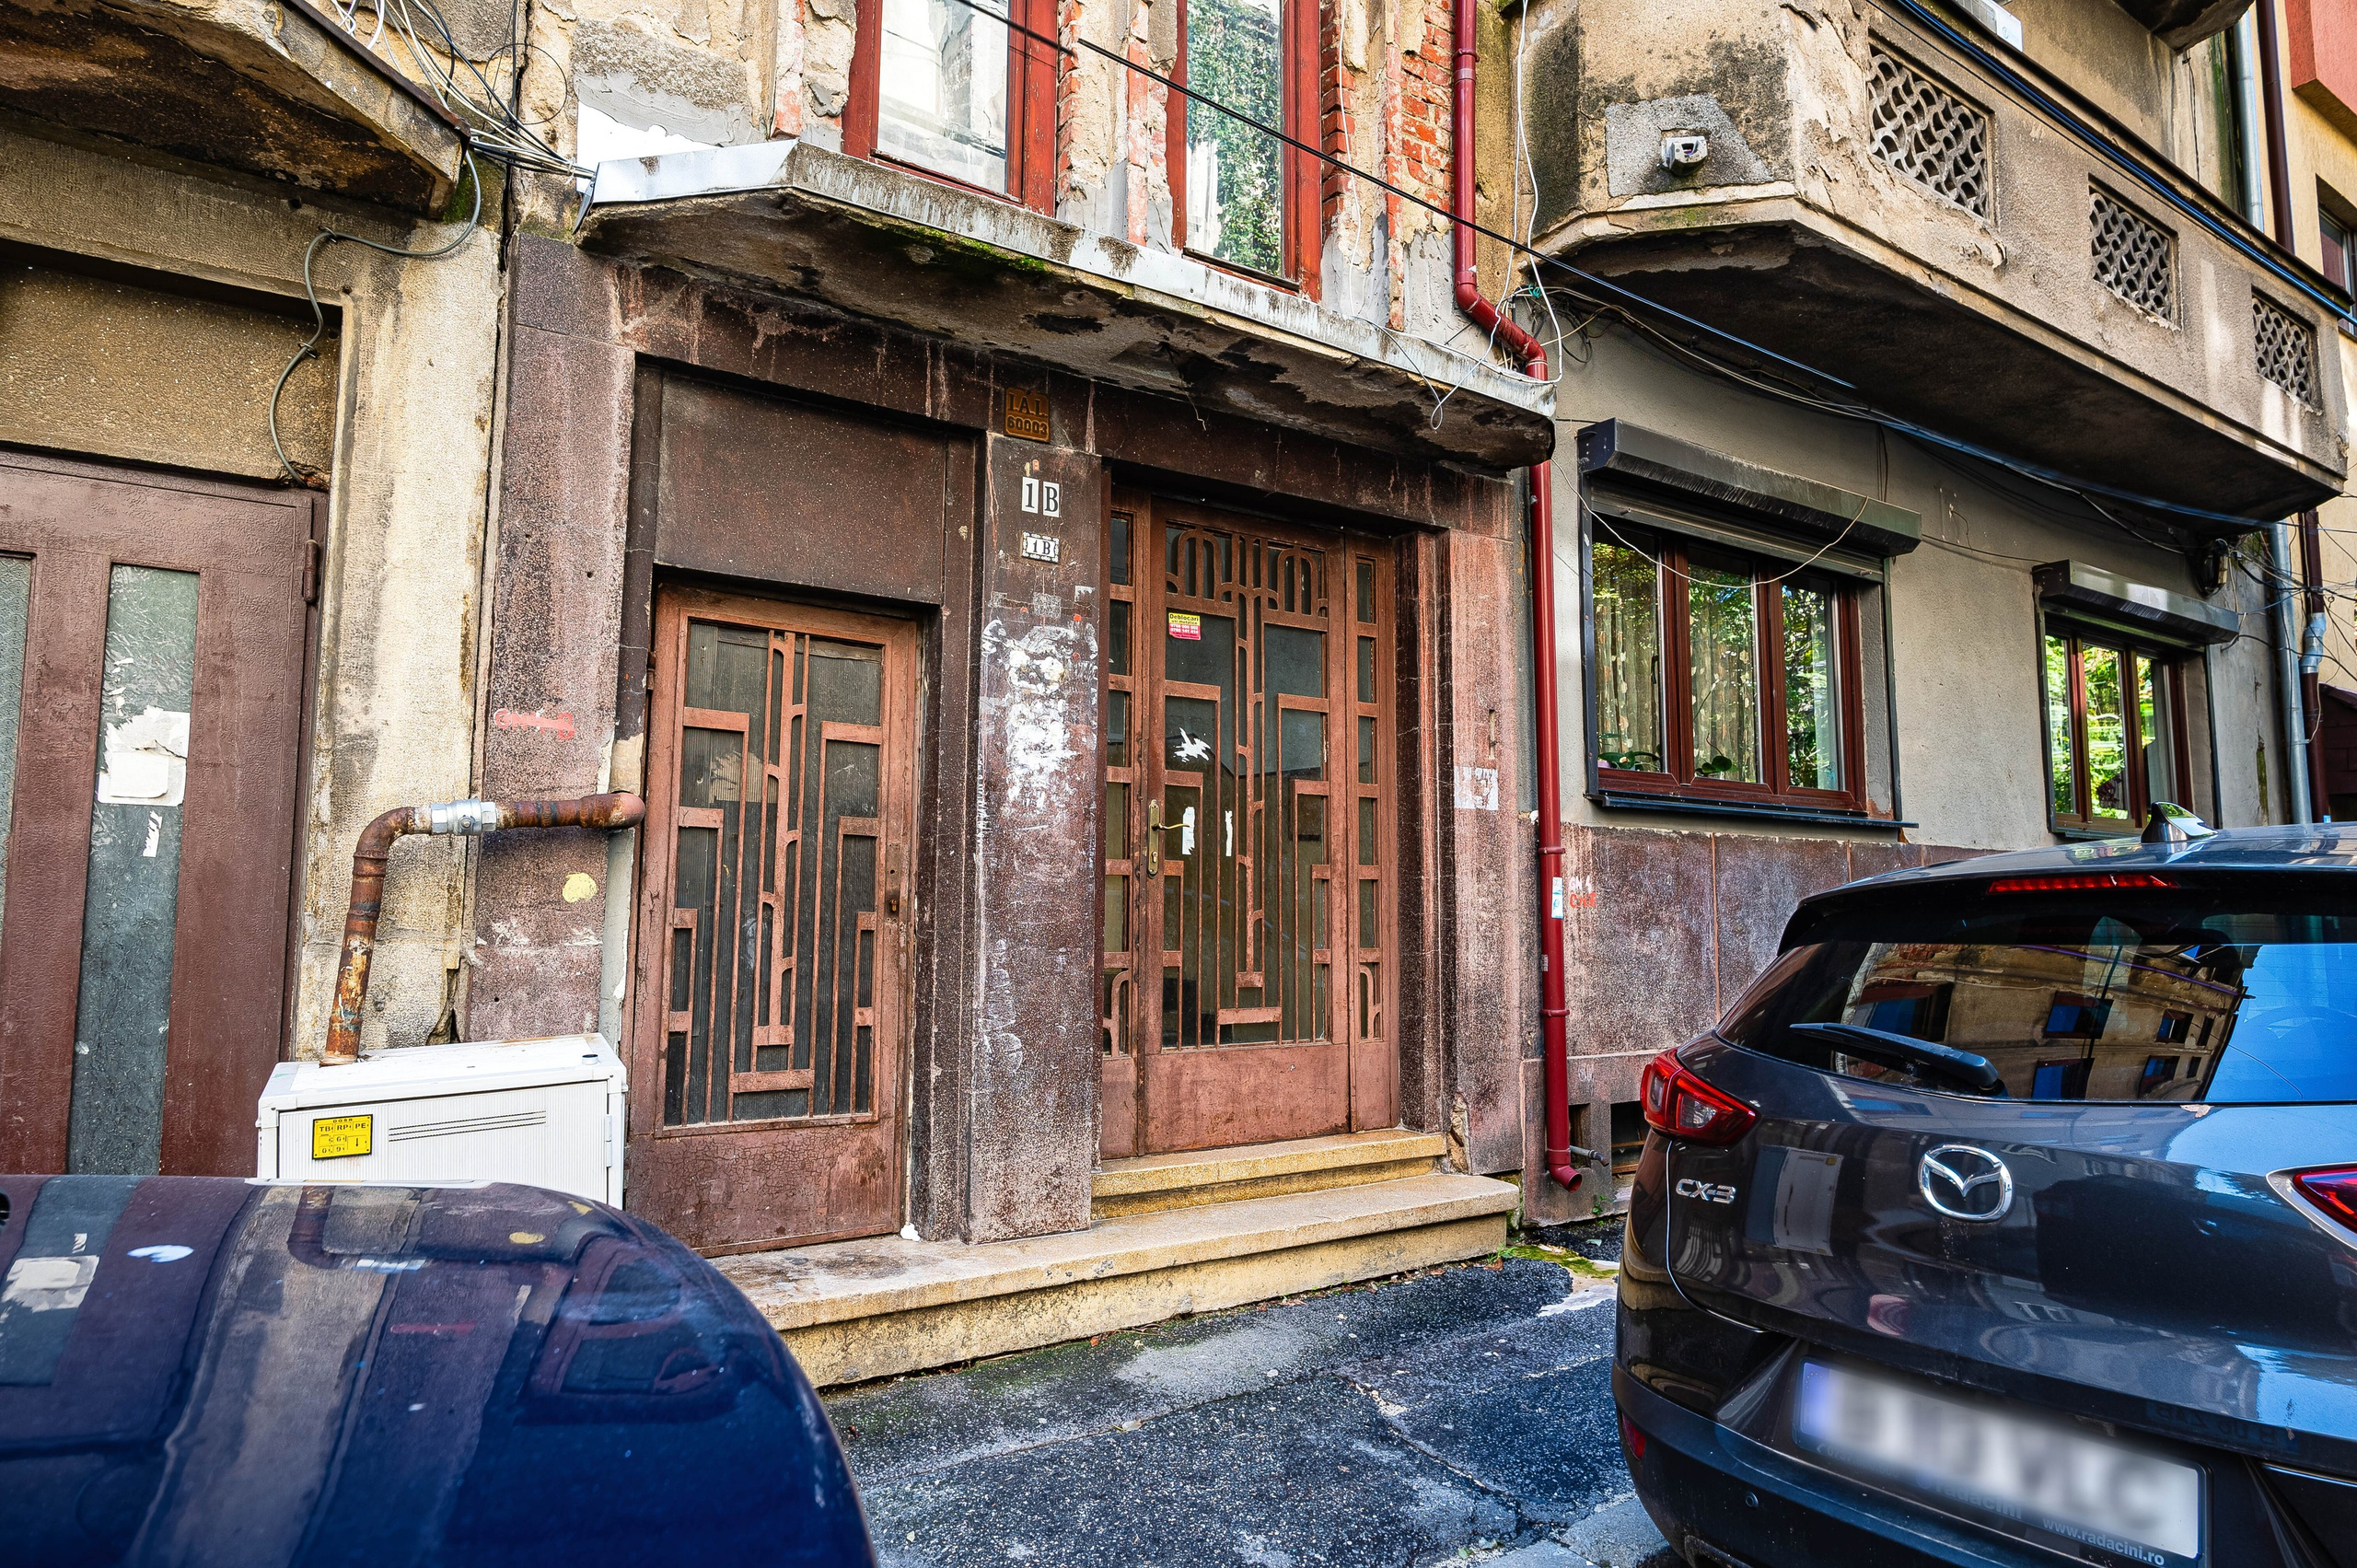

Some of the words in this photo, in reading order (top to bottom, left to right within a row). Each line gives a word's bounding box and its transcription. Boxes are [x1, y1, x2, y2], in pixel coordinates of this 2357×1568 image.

[1007, 415, 1048, 435] 60003
[1676, 1178, 1736, 1204] CX-3
[2042, 1516, 2165, 1566] www.radacini.ro
